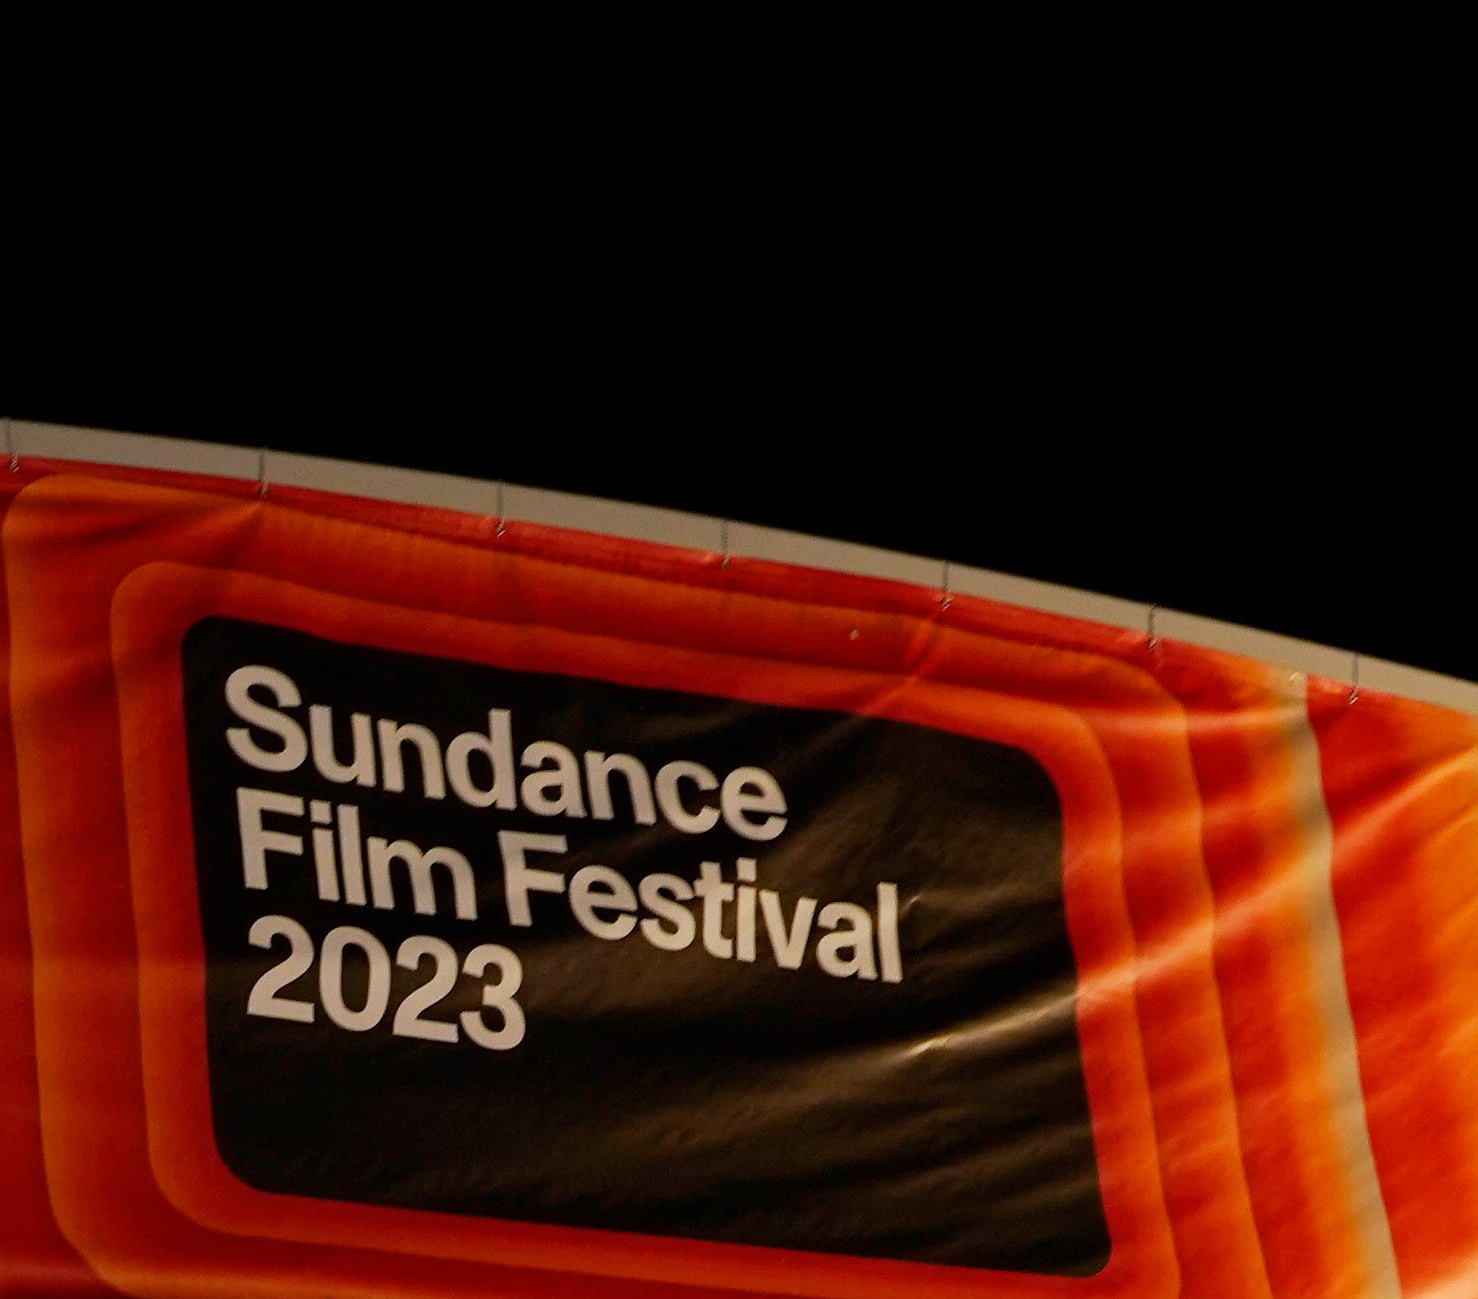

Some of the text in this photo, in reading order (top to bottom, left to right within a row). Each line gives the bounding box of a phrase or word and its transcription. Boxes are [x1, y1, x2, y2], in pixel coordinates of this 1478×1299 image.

[225, 664, 786, 841] Sundance
[237, 787, 904, 984] Film Festival
[246, 915, 526, 1052] 2023
